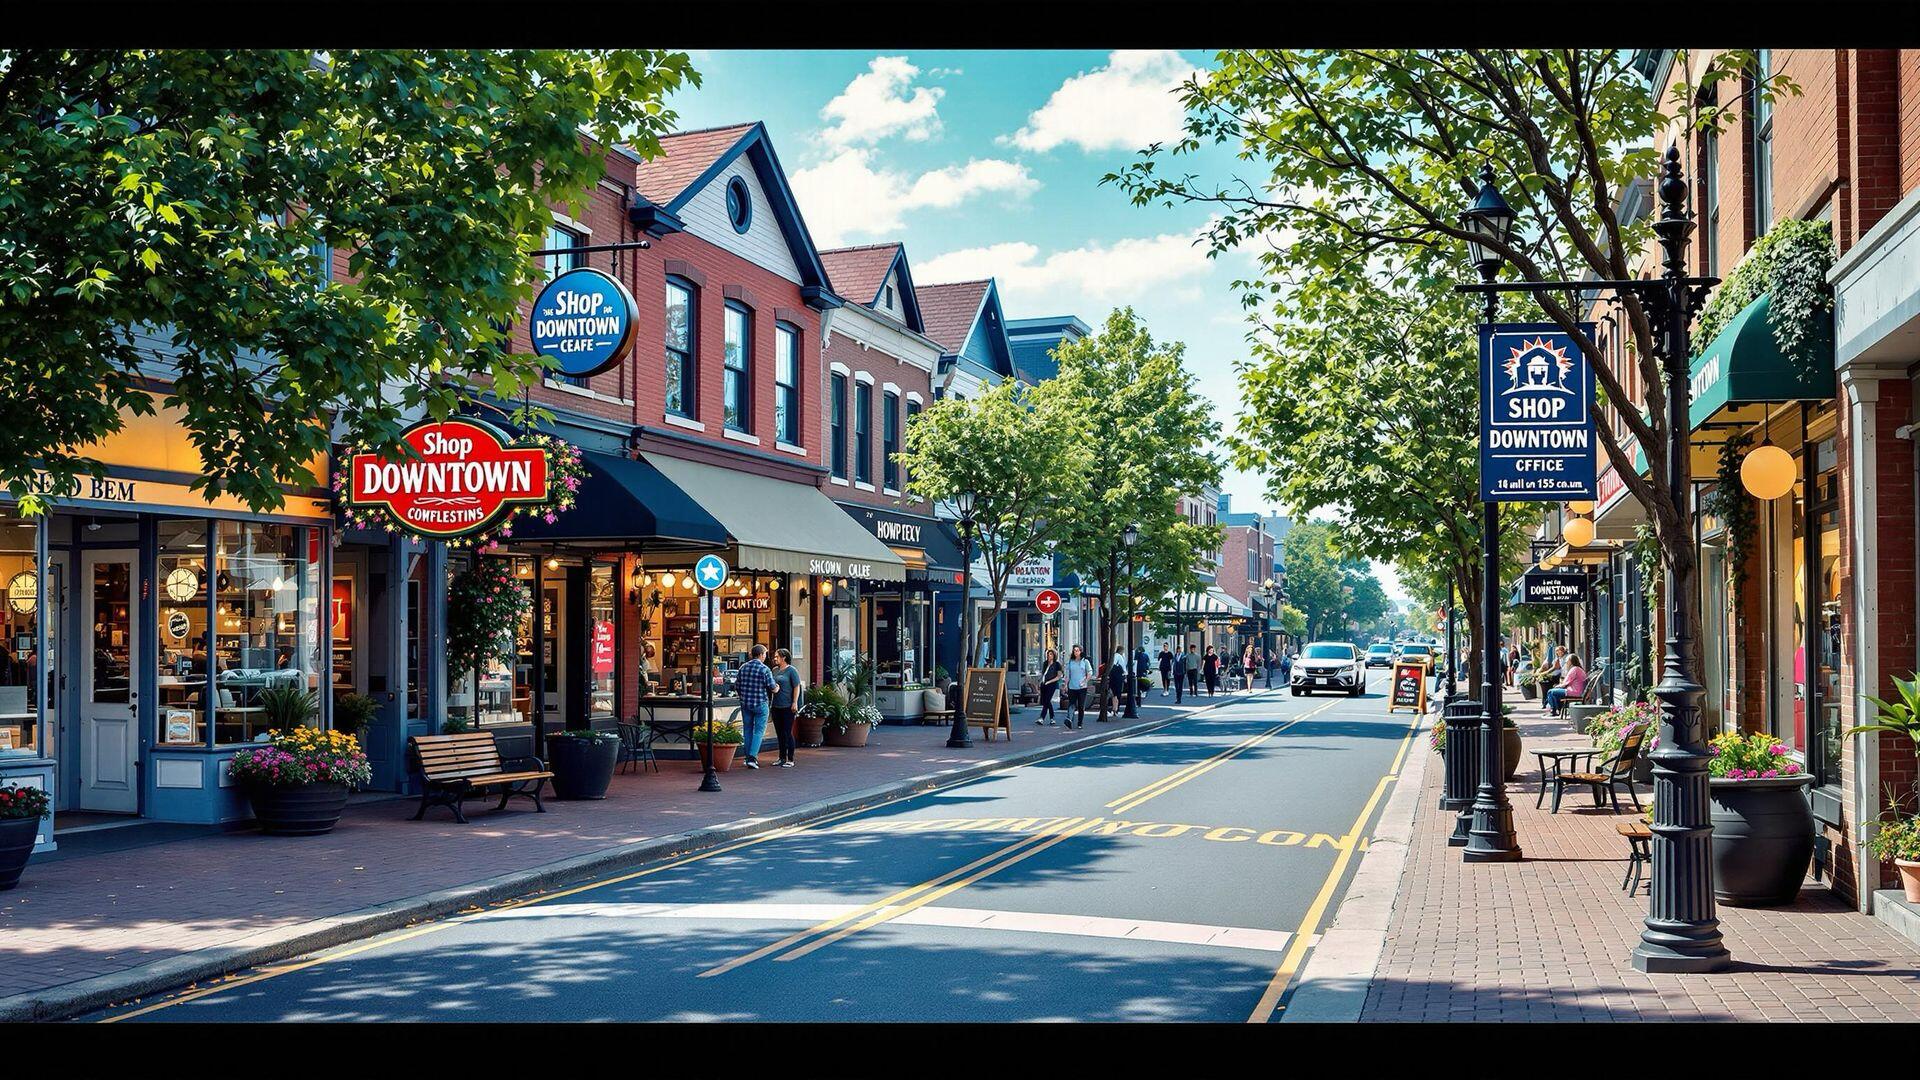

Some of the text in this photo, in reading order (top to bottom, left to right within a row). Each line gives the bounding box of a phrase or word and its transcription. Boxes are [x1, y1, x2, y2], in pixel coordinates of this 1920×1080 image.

[555, 290, 604, 316] SHOP
[536, 316, 620, 338] DOWNTOWN
[560, 338, 594, 353] CEAFE
[1508, 397, 1566, 419] SHOP
[423, 432, 473, 460] Shop
[1489, 429, 1588, 449] DOWNTOWN
[362, 461, 531, 494] DOWNTOWN
